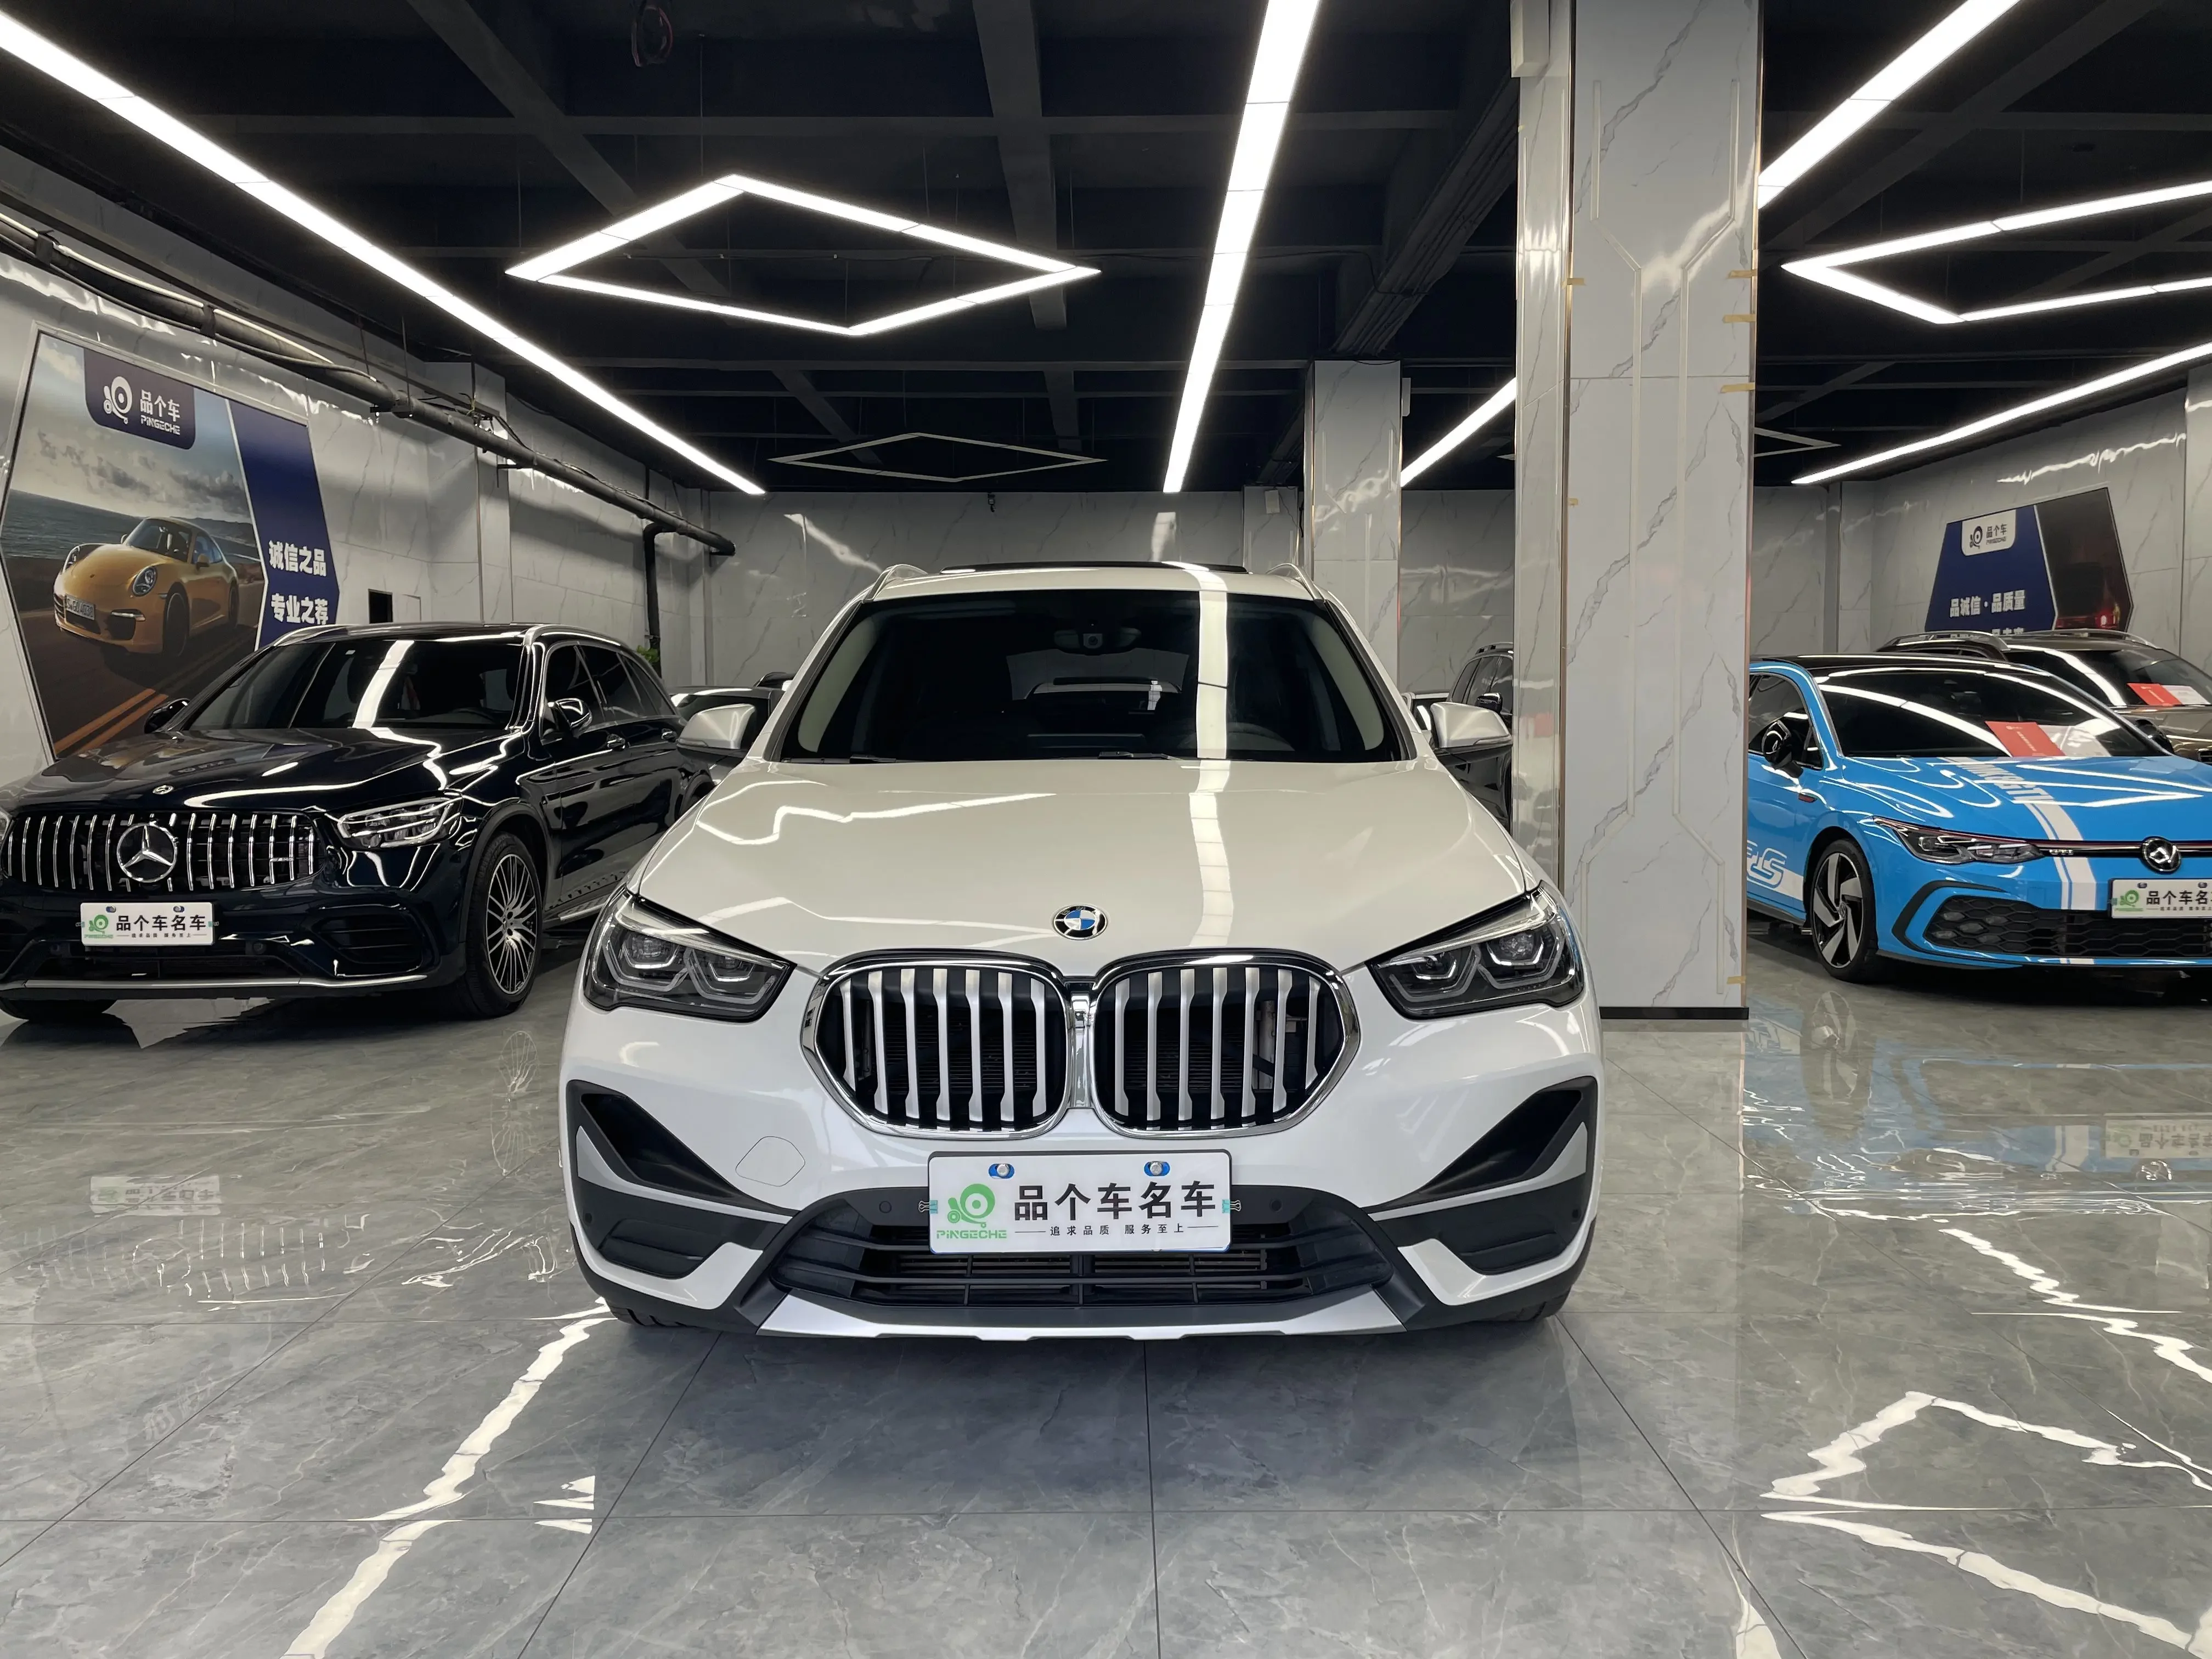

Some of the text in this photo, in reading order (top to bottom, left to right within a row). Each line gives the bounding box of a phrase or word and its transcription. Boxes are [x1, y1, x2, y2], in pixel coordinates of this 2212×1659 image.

[140, 389, 180, 422] 品个车
[1986, 523, 2007, 538] 品个车
[268, 540, 326, 577] 诚信之品
[271, 593, 329, 625] 专业之荐
[2146, 890, 2212, 905] 品个车名
[116, 915, 206, 931] 品个车名车
[1014, 1180, 1216, 1222] 品个车名车
[1050, 1223, 1184, 1237] 追求品质 服务至上
